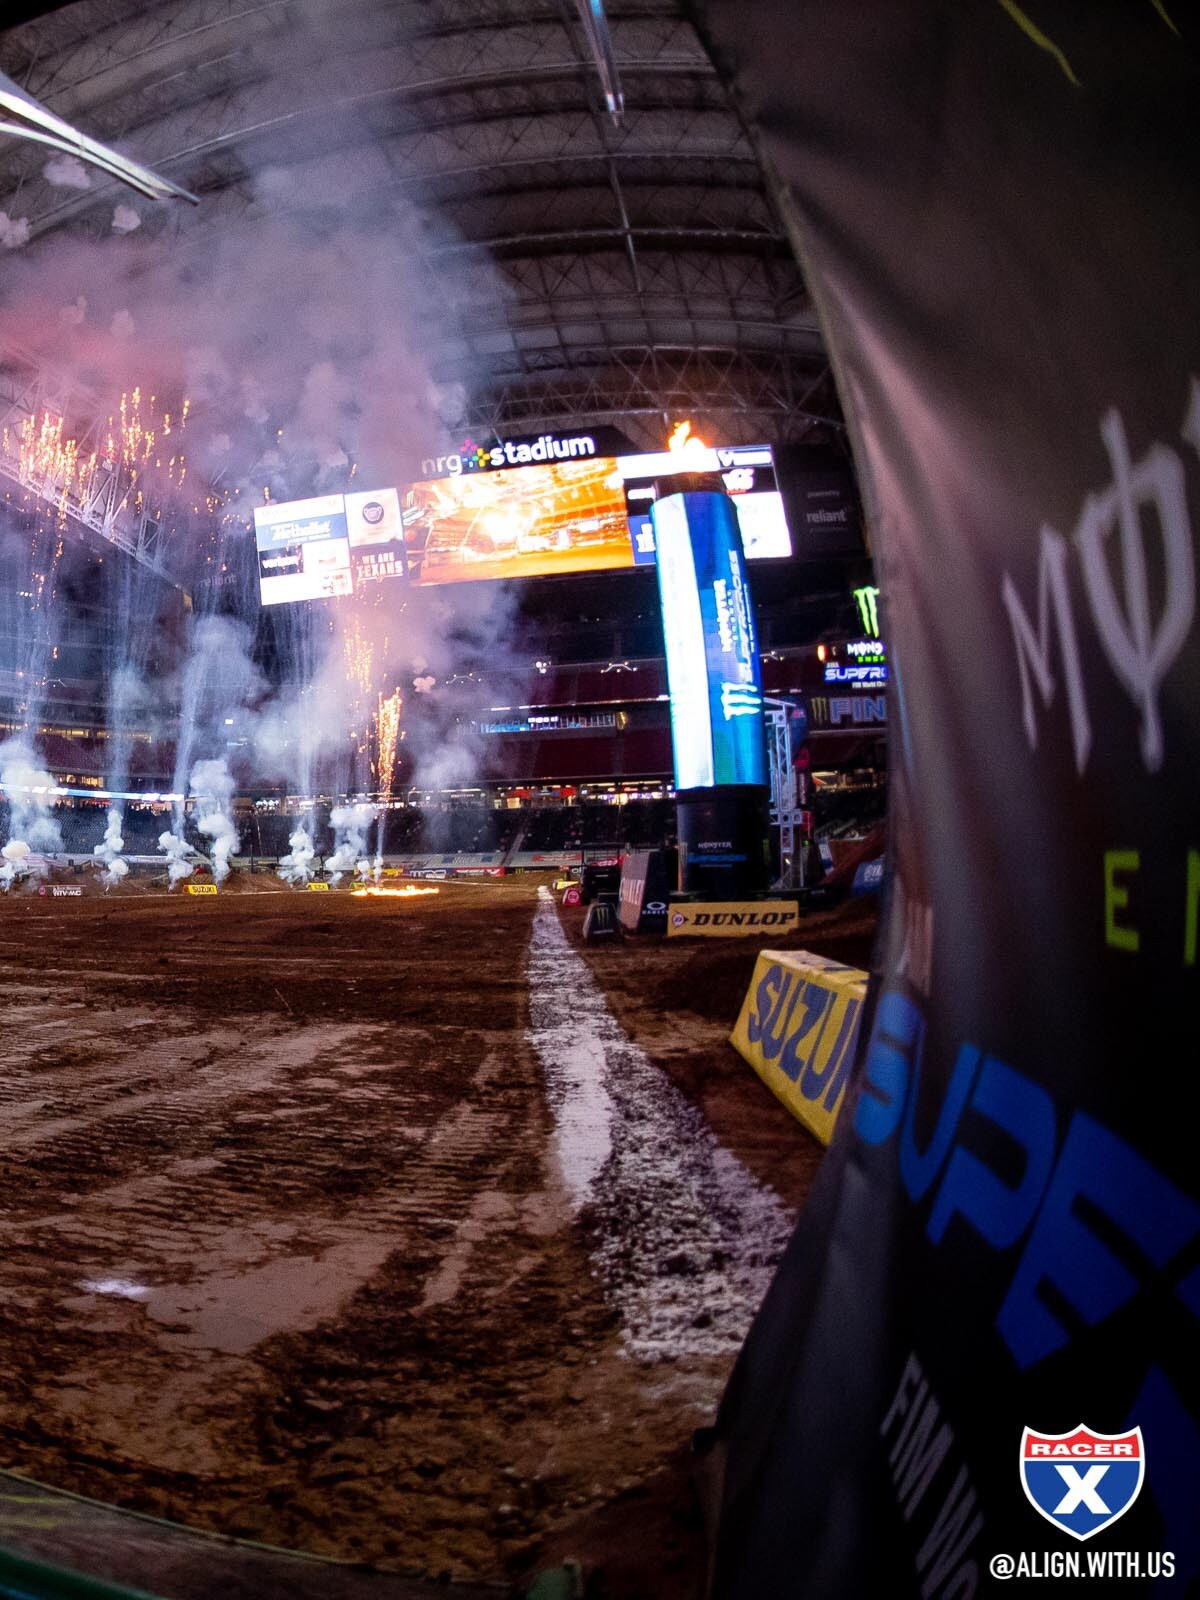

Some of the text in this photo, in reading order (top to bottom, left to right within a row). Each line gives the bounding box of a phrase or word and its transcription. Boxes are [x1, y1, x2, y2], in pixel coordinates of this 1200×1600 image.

[421, 434, 596, 477] nrg stadium
[807, 510, 846, 523] reliant
[357, 561, 404, 578] TEXANS
[692, 912, 796, 926] DUNLOP
[853, 991, 1200, 1375] SUPE
